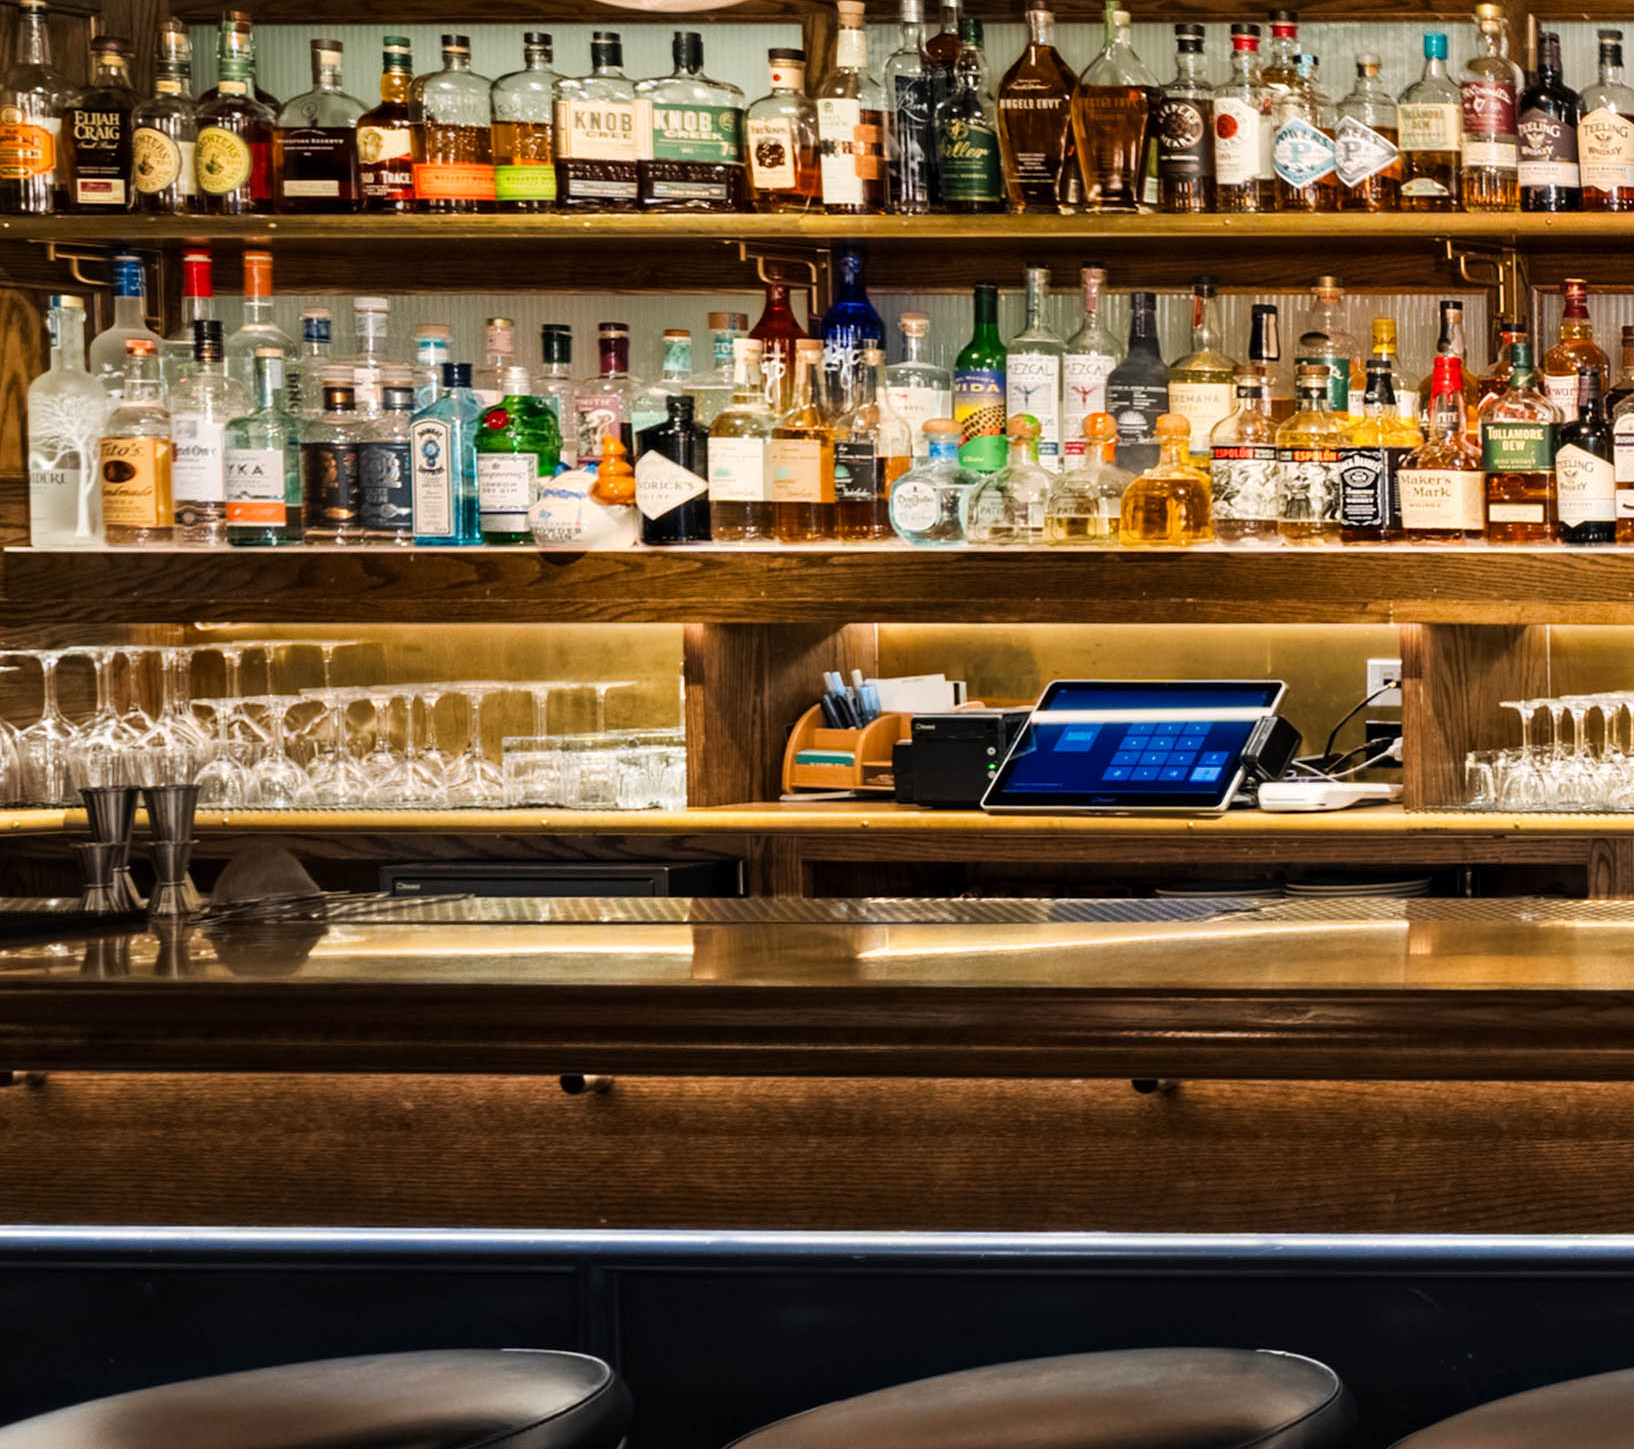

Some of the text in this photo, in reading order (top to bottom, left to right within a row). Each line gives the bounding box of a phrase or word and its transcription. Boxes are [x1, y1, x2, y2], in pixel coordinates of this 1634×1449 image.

[74, 111, 120, 126] ELIJAH
[574, 113, 633, 131] KNOB
[654, 109, 712, 131] KNOB
[74, 125, 120, 142] CRAIG
[585, 131, 632, 140] CREE
[664, 130, 723, 141] CREEK
[1518, 123, 1560, 138] TEELING
[1583, 123, 1629, 137] TEELING
[1292, 143, 1311, 163] P
[383, 170, 411, 184] TRACE
[954, 383, 1001, 393] VIDA
[1487, 427, 1544, 440] TULLAMORE
[1503, 440, 1526, 452] DEW
[226, 465, 263, 475] YKA
[1401, 475, 1452, 485] Maker's
[1413, 487, 1451, 498] Mark
